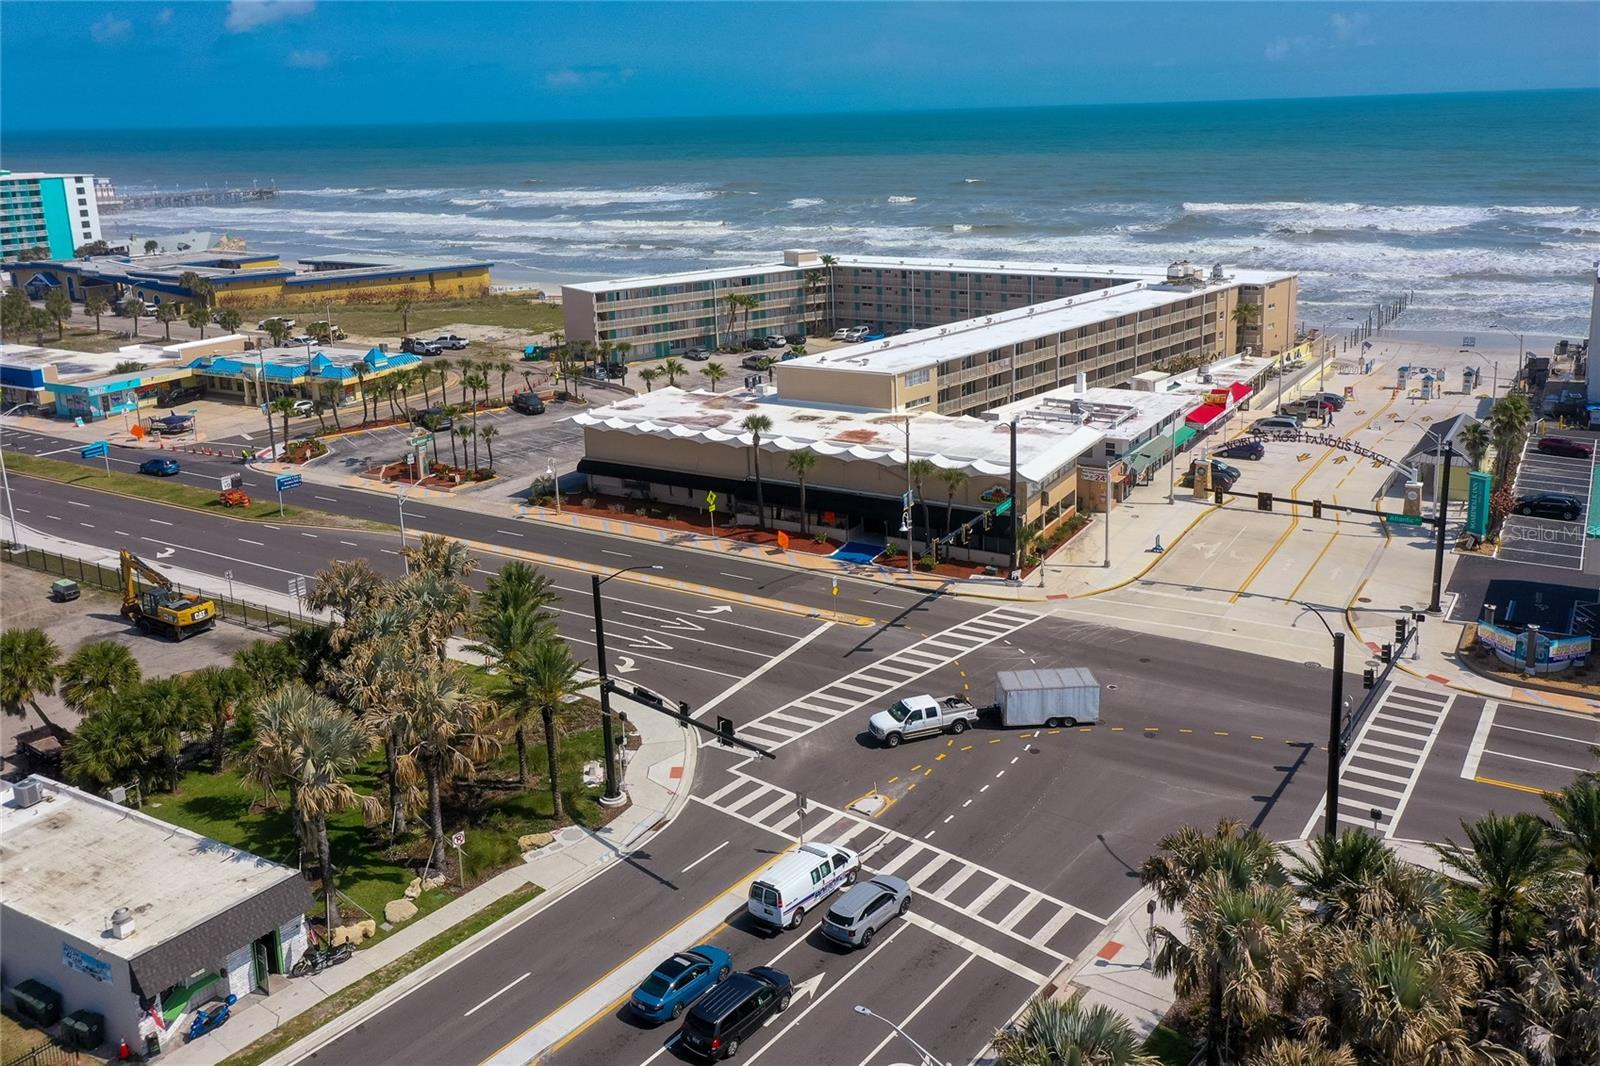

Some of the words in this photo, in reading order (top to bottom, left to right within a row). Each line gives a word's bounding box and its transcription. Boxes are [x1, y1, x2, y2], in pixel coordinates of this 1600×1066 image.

[1224, 434, 1269, 450] WORLD'S
[1273, 434, 1303, 443] MOST
[1305, 435, 1351, 451] FAMOUS
[1353, 445, 1392, 467] BEACH
[194, 610, 206, 620] CAT
